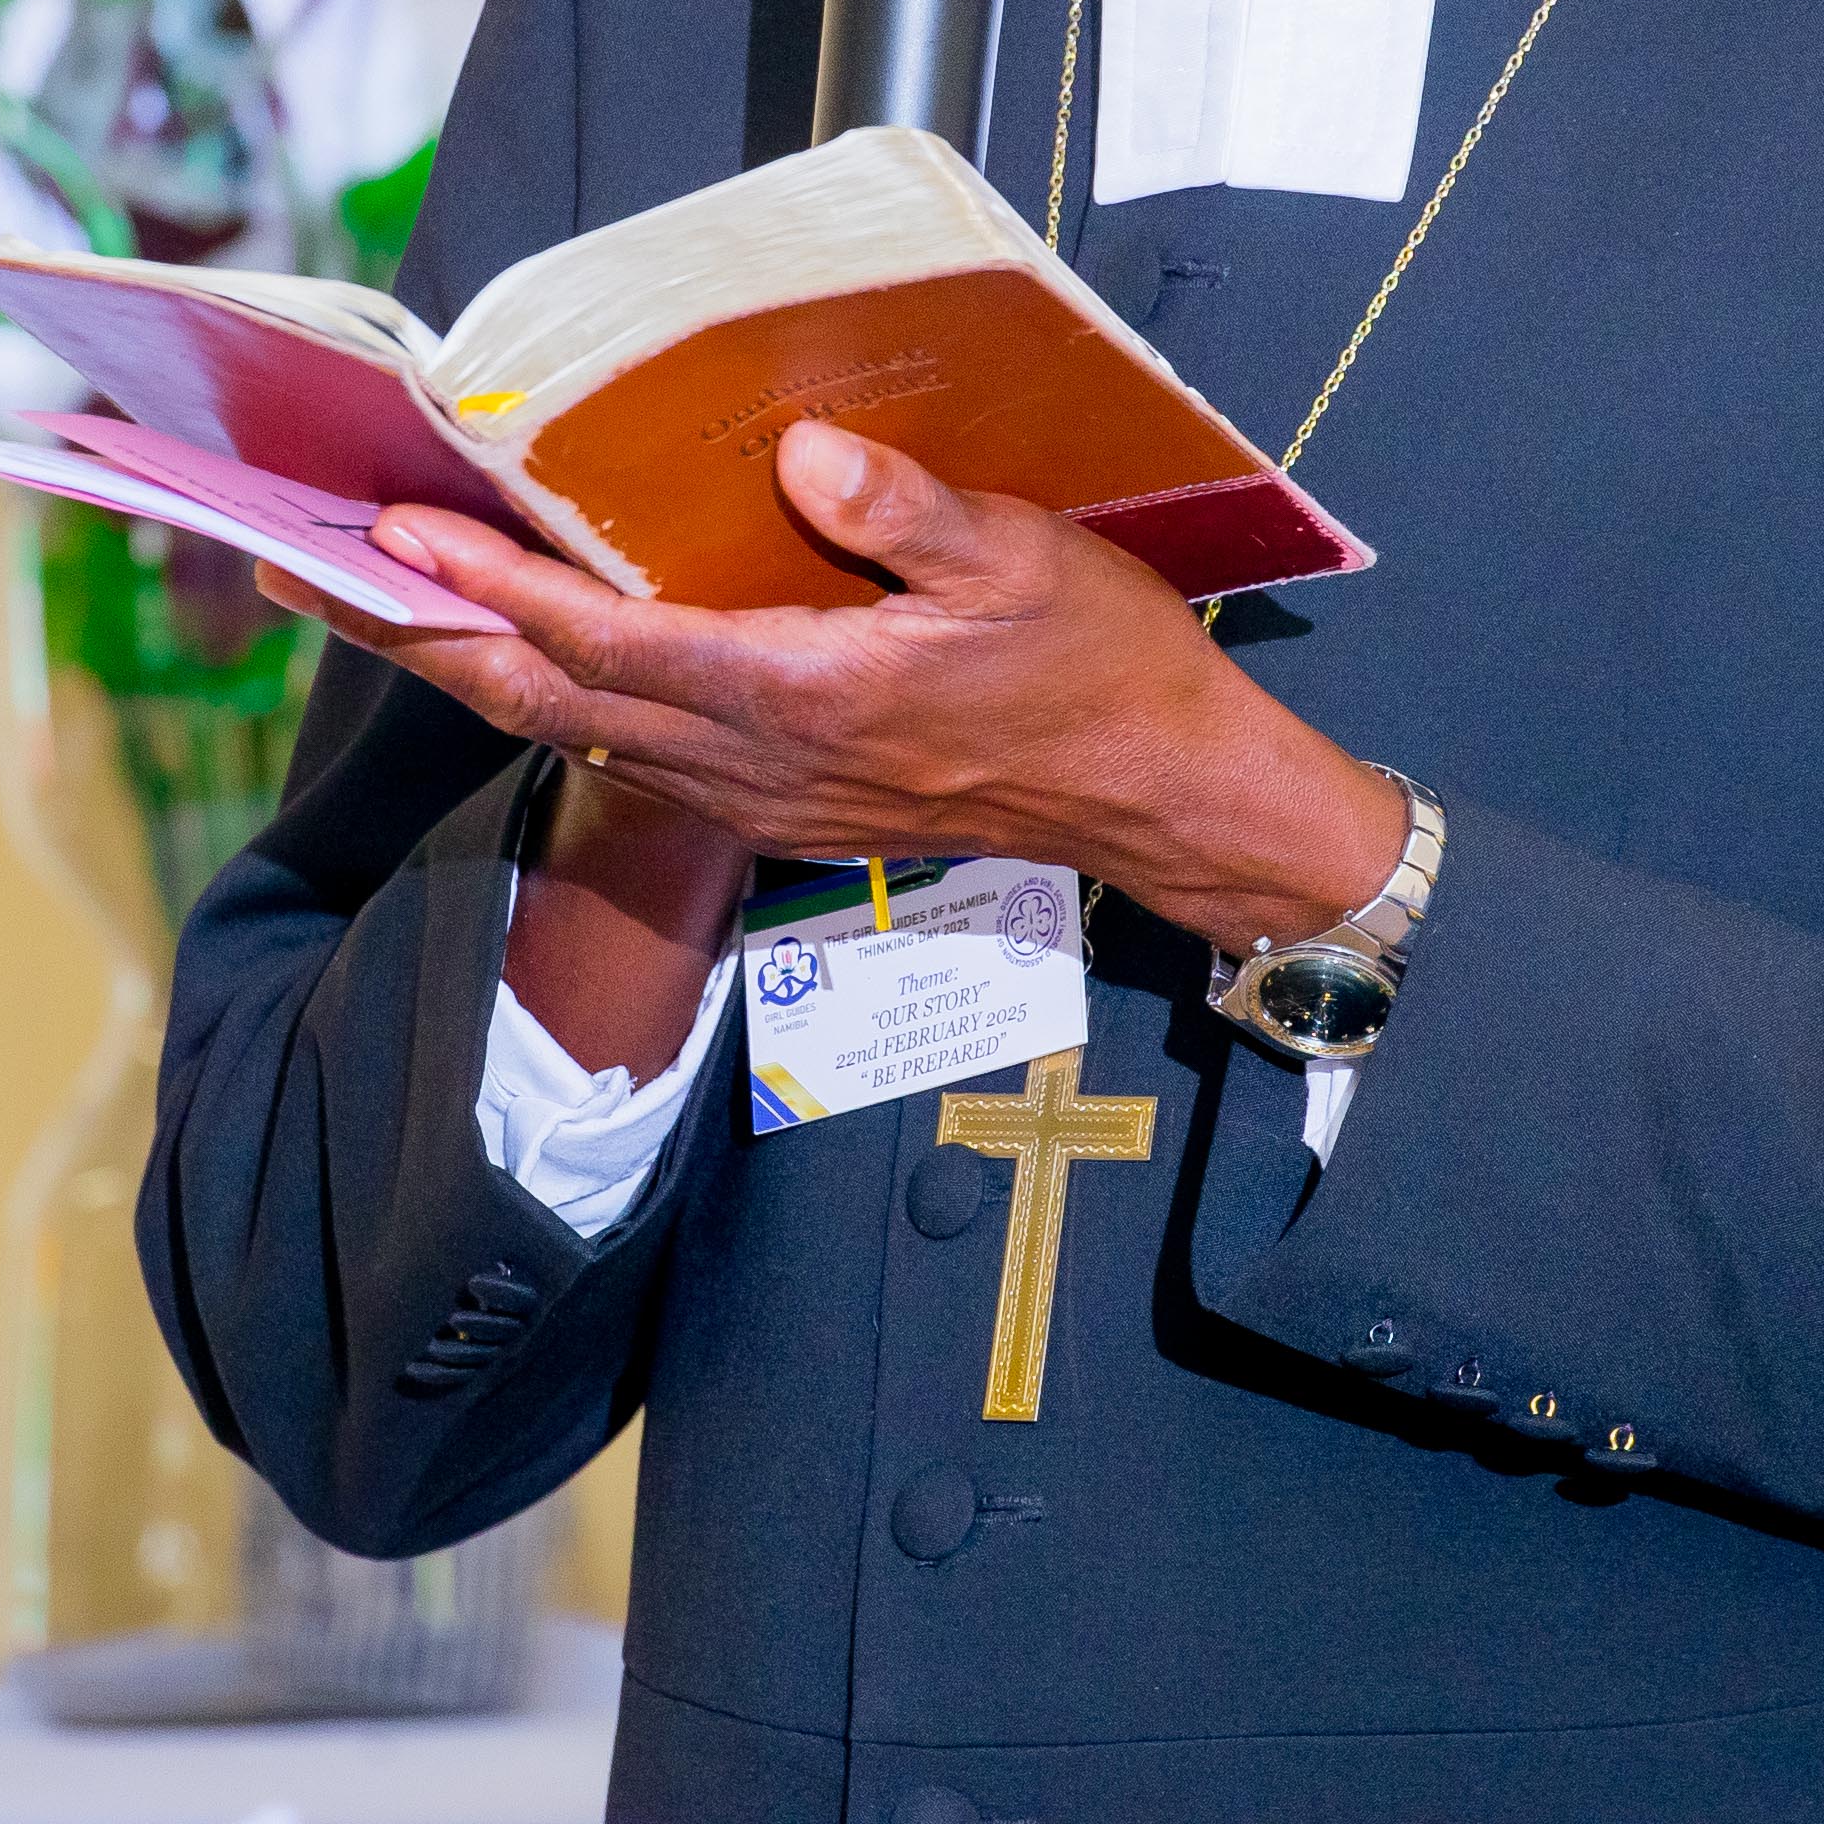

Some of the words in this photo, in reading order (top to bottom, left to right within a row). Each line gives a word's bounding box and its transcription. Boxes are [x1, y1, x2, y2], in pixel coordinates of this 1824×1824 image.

[825, 933, 849, 949] THE
[890, 911, 928, 931] UIDES
[931, 905, 945, 920] OF
[949, 890, 999, 916] NAMIBIA
[857, 934, 914, 961] THINKING
[918, 926, 942, 944] DAY
[944, 917, 971, 936] 2025
[1002, 948, 1043, 968] ASSOCIATION
[898, 967, 960, 996] Theme:
[835, 1039, 878, 1070] 22nd
[883, 1011, 983, 1057] FEBRUARY
[985, 1002, 1028, 1028] 2025
